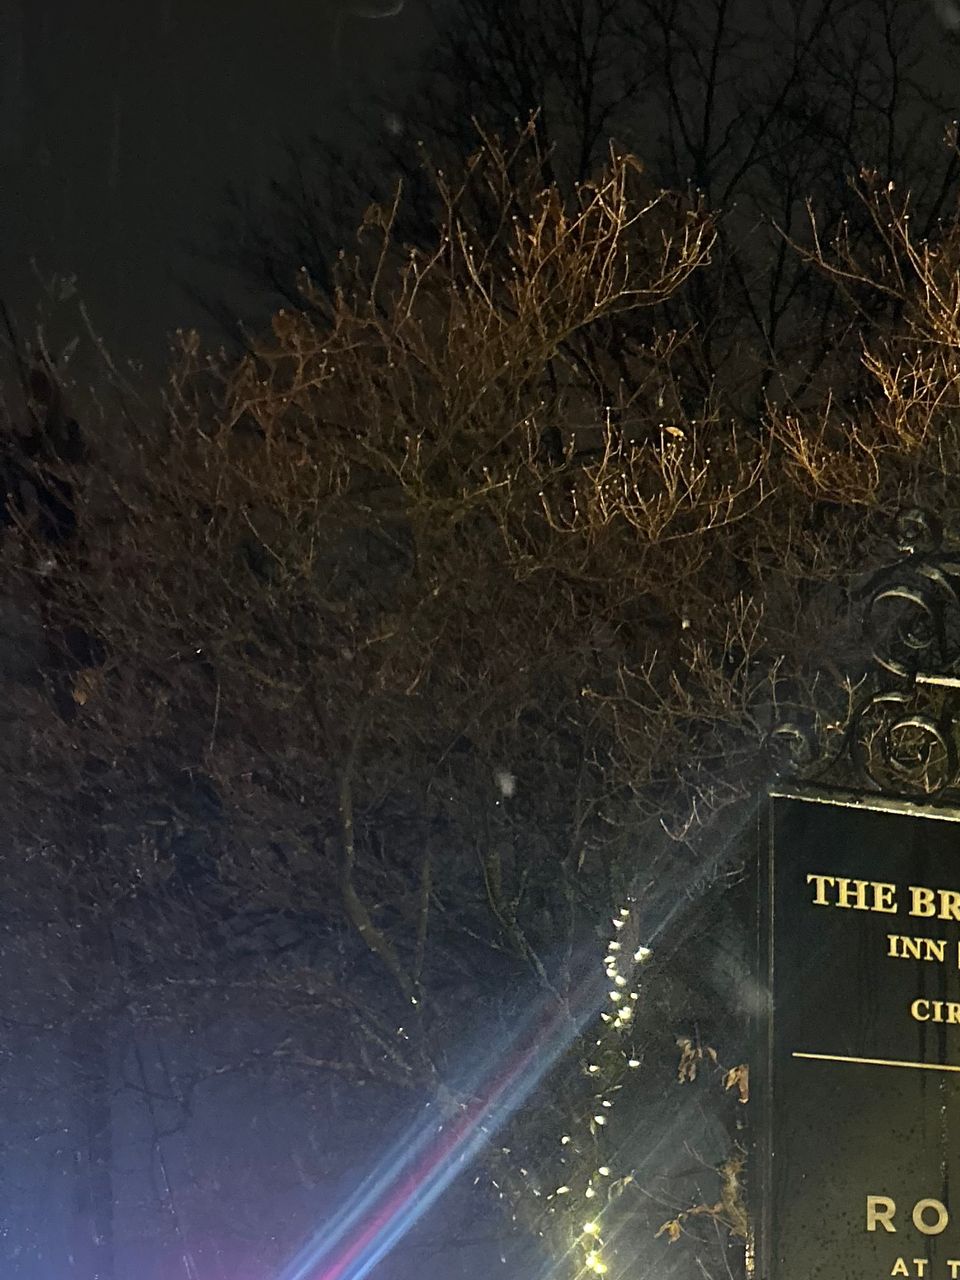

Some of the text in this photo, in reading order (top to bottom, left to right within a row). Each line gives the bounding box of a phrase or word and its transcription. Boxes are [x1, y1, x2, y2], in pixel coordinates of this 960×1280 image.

[806, 874, 898, 914] THE
[887, 934, 948, 963] INN
[891, 1257, 929, 1278] AT
